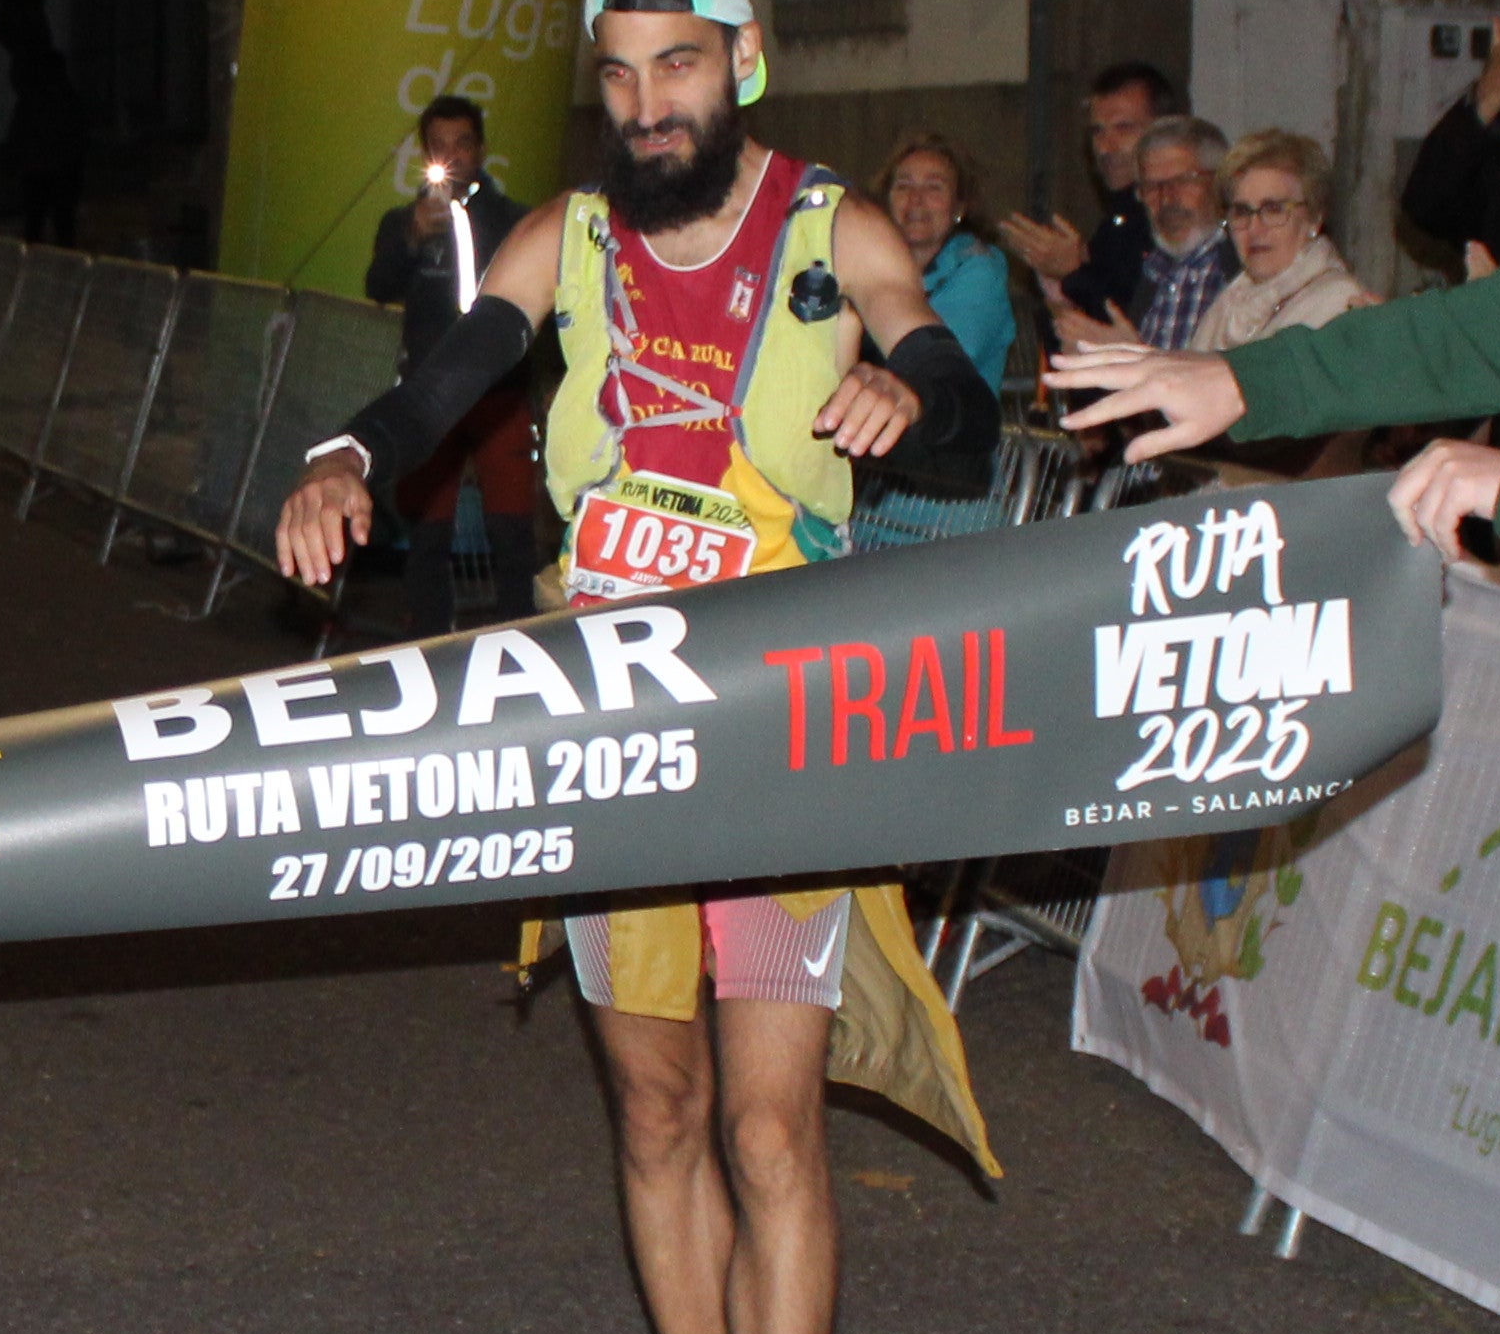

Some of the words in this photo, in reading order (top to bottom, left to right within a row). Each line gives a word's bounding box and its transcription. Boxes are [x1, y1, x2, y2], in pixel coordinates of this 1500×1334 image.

[600, 508, 727, 582] 1035
[652, 486, 703, 516] VETONA
[1123, 499, 1285, 617] RUTA
[763, 628, 1034, 771] TRAIL
[1094, 597, 1353, 719] VETONA
[143, 769, 302, 849] RUTA
[308, 745, 536, 832] VETONA
[545, 729, 699, 805] 2025
[1116, 698, 1312, 792] 2025
[1064, 802, 1152, 826] BÉJAR
[269, 853, 328, 901] 27
